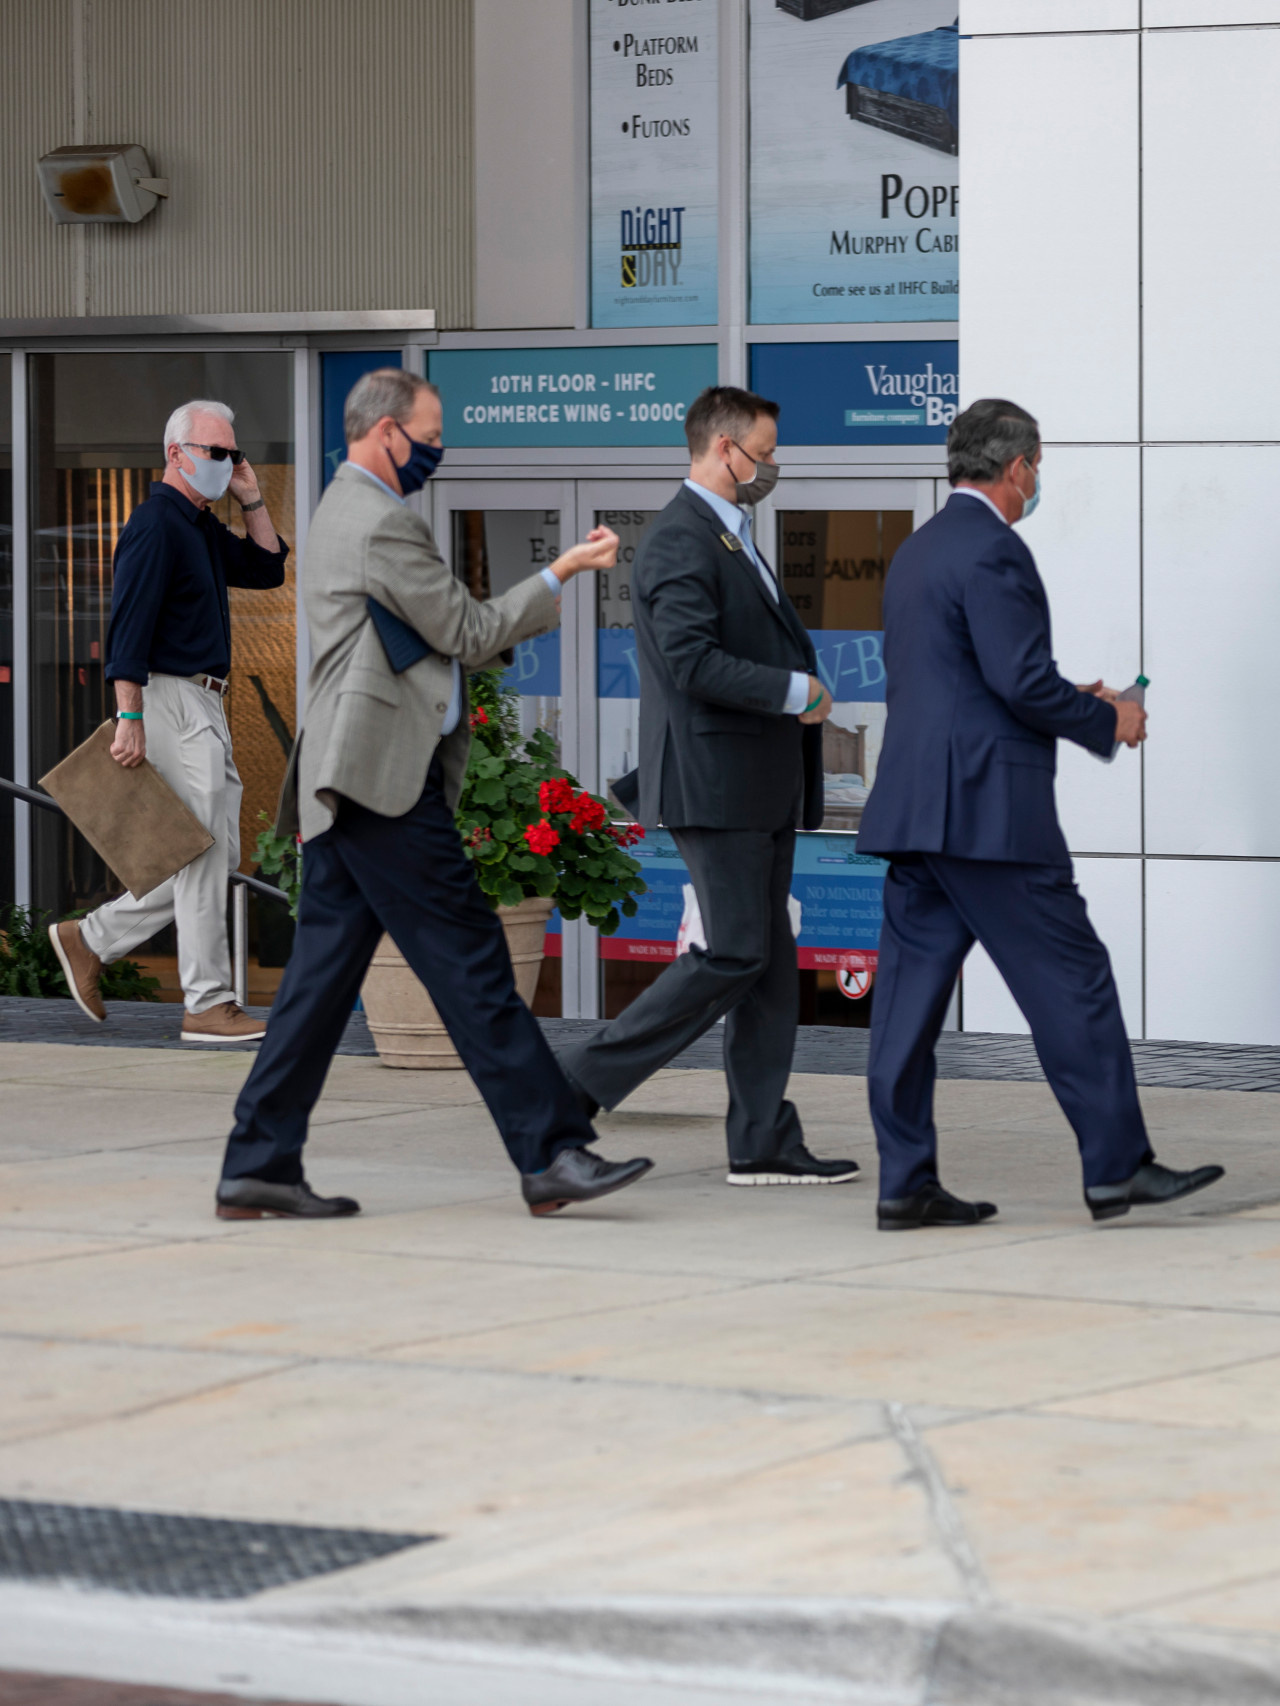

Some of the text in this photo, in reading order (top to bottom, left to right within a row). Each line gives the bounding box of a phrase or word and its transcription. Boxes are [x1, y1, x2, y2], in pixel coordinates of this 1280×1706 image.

[812, 282, 845, 297] Come
[847, 284, 866, 296] see
[869, 284, 882, 296] us
[884, 282, 895, 295] at
[898, 280, 928, 295] IHFC
[491, 375, 533, 393] 10TH
[537, 373, 597, 392] FLOOR
[614, 372, 656, 391] IHFC
[863, 362, 959, 407] Vaugha
[463, 405, 560, 424] COMMERCE
[563, 403, 611, 422] WING
[814, 953, 837, 964] MADE
